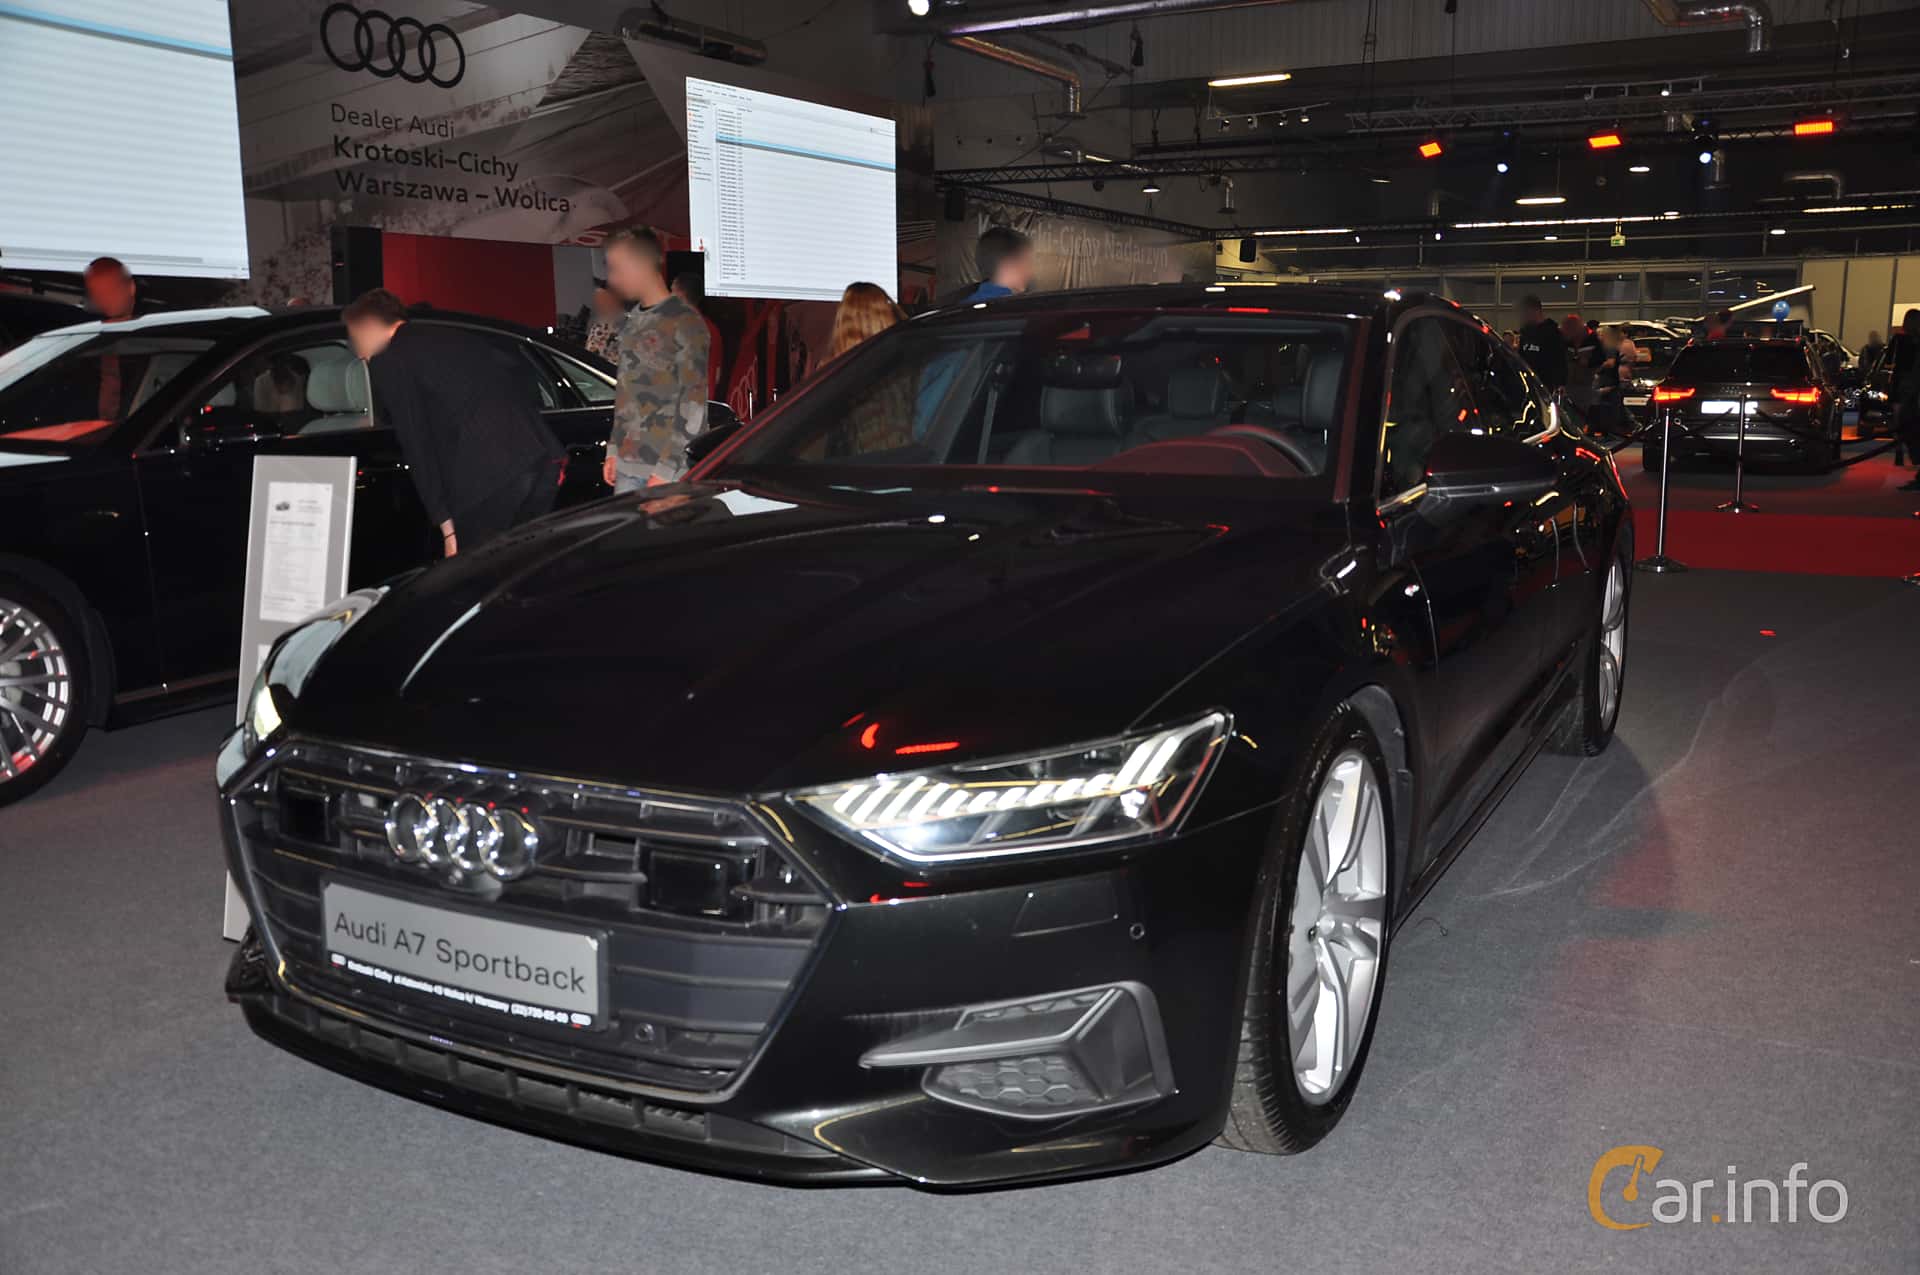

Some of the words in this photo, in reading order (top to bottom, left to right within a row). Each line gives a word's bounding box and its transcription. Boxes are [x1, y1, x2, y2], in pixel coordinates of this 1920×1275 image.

[331, 103, 403, 131] Dealer
[409, 115, 455, 139] Audi
[333, 135, 519, 182] Krotoski-Cichy
[336, 169, 468, 204] Warszawa
[496, 187, 570, 213] Wolica
[334, 912, 387, 947] Audi
[394, 930, 425, 956] A7
[436, 939, 585, 993] Sportback
